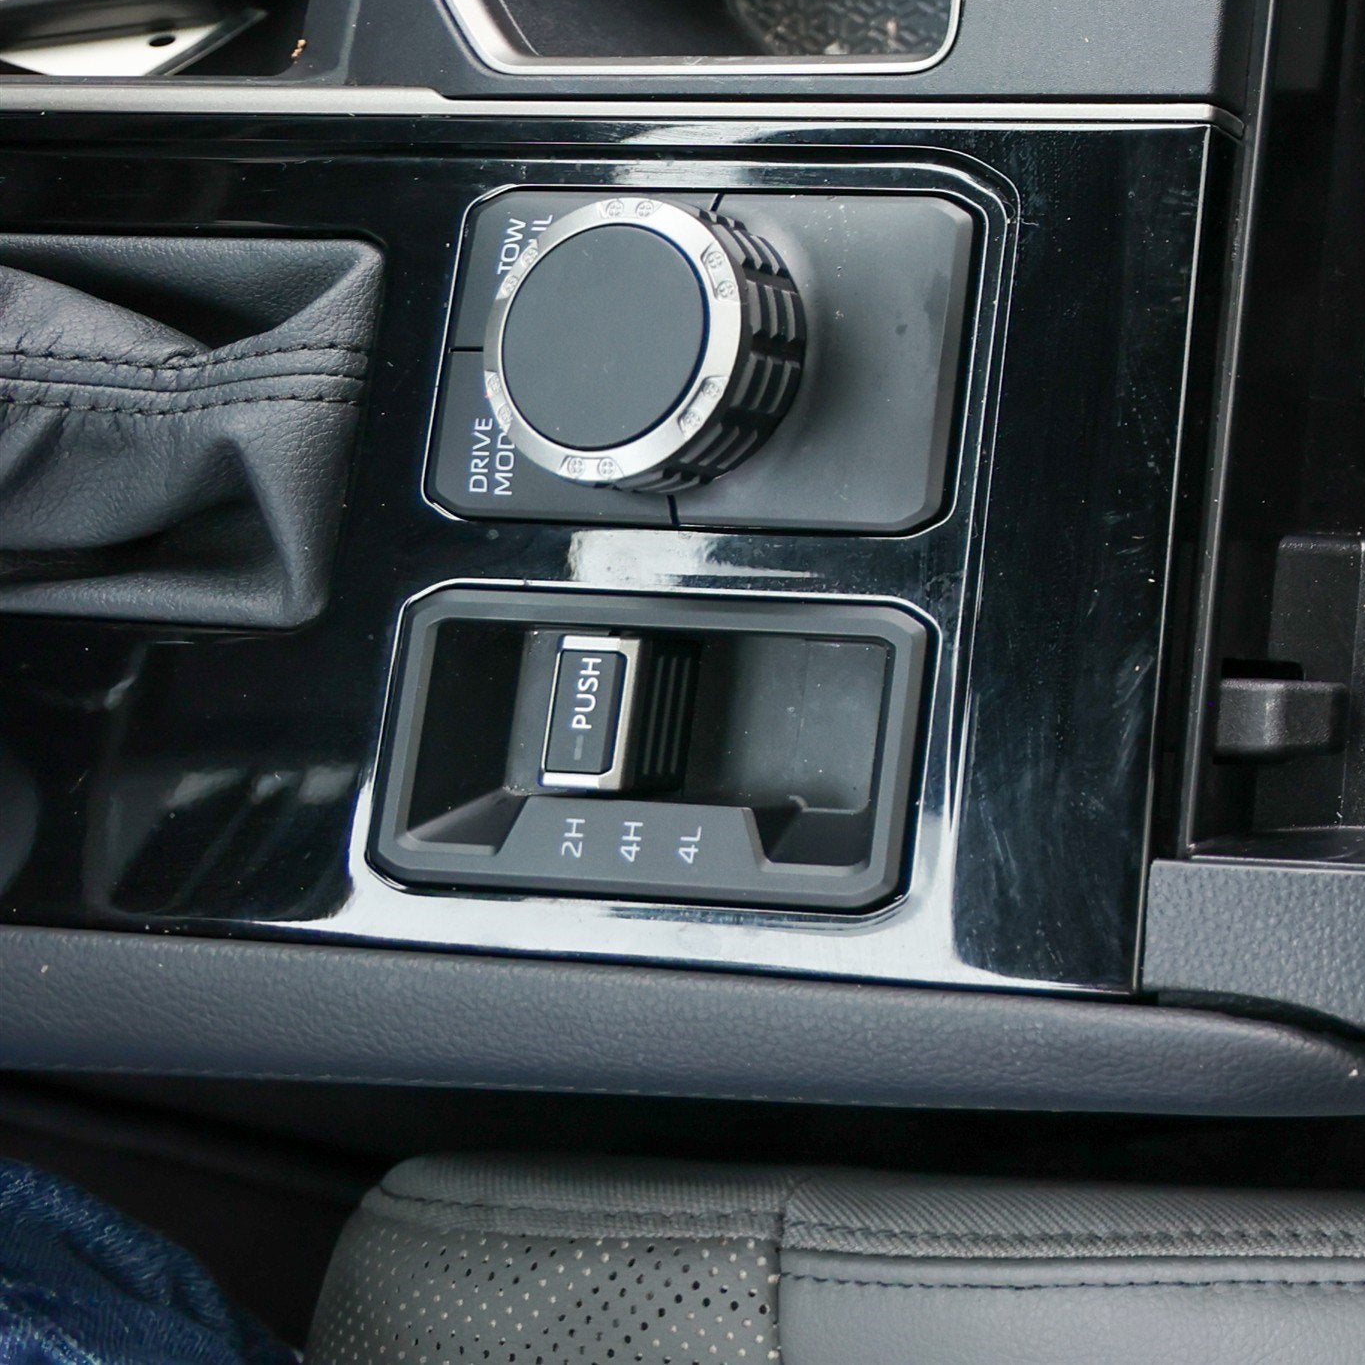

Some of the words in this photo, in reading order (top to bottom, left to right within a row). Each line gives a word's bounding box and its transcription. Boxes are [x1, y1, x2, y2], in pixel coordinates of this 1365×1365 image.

[496, 217, 527, 275] TOW
[468, 417, 494, 493] DRIVE
[493, 428, 516, 496] MOD
[571, 657, 603, 730] PUSH
[560, 817, 586, 859] 2H
[619, 821, 644, 863] 4H
[677, 825, 703, 865] 4L
